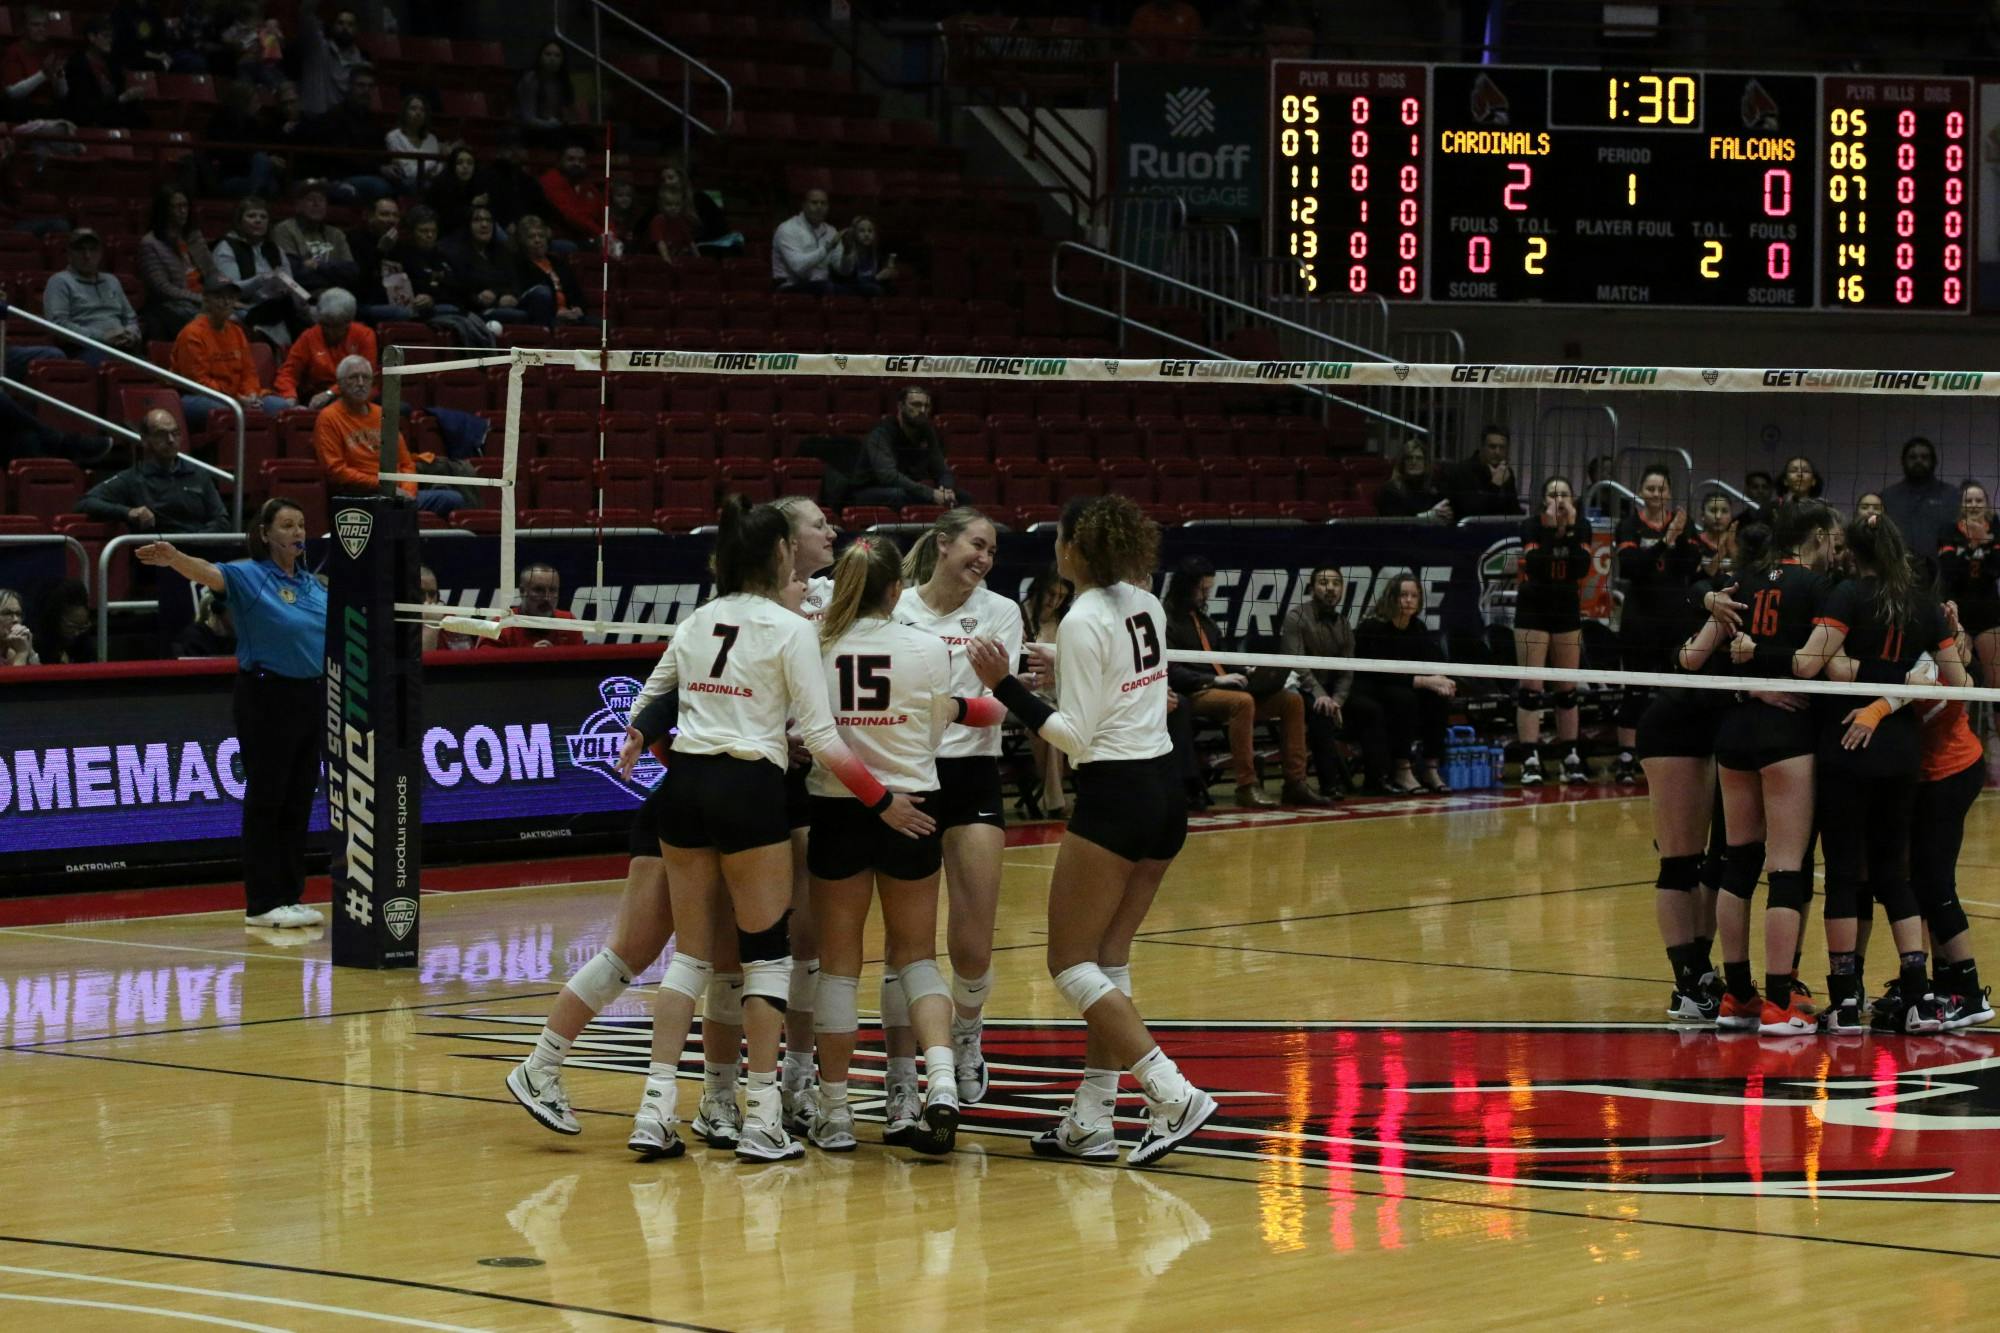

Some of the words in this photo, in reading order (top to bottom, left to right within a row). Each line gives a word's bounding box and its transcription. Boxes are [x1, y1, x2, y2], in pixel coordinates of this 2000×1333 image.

[1299, 70, 1329, 88] PLYR
[1336, 71, 1369, 88] KILLS
[1377, 73, 1406, 89] DIGS
[1282, 95, 1319, 123] 05
[1352, 96, 1369, 124] 0
[1402, 98, 1418, 125] 0
[1610, 76, 1695, 124] 1:30
[1831, 109, 1867, 136] 05
[1898, 110, 1915, 137] 0
[1946, 112, 1964, 138] 0
[1282, 129, 1319, 156] 07
[1352, 130, 1368, 157] 0
[1411, 134, 1418, 156] 1
[1442, 131, 1550, 155] CARDINALS
[1598, 148, 1651, 164] PERIOD
[1711, 137, 1795, 161] FALCONS
[1830, 142, 1866, 169] 06
[1898, 143, 1915, 170] 0
[1946, 145, 1963, 171] 0
[1129, 143, 1251, 180] Ruoff
[1292, 165, 1318, 188] 11
[1351, 164, 1368, 191] 0
[1401, 165, 1418, 192] 0
[1504, 163, 1531, 210] 2
[1629, 174, 1636, 205] 1
[1764, 169, 1791, 216] 0
[1830, 175, 1866, 202] 07
[1897, 176, 1914, 203] 0
[1945, 178, 1962, 205] 0
[1291, 197, 1318, 224] 12
[1361, 200, 1367, 222] 1
[1400, 199, 1417, 226] 0
[1450, 217, 1499, 232] FOULS
[1840, 211, 1865, 233] 11
[1897, 210, 1914, 237] 0
[1945, 211, 1962, 238] 0
[1576, 219, 1632, 236] PLAYER
[1638, 220, 1675, 237] FOUL
[1750, 224, 1797, 239] FOULS
[1291, 231, 1317, 258] 13
[1350, 232, 1367, 259] 0
[1400, 232, 1416, 260] 0
[1469, 236, 1490, 273] 0
[1525, 237, 1547, 274] 2
[1701, 241, 1722, 278] 2
[1839, 244, 1865, 266] 14
[1897, 243, 1913, 270] 0
[1944, 244, 1961, 271] 0
[1768, 243, 1790, 279] 0
[1350, 265, 1366, 292] 0
[1399, 266, 1416, 293] 0
[1450, 282, 1497, 298] SCORE
[1839, 275, 1864, 302] 16
[1896, 276, 1913, 303] 0
[1944, 277, 1961, 304] 0
[1597, 286, 1649, 302] MATCH
[1748, 288, 1795, 304] SCORE
[340, 525, 369, 537] MAC
[1751, 587, 1783, 637] 16
[708, 623, 740, 679] 7
[1125, 611, 1161, 674] 13
[687, 683, 753, 698] ARDINALS
[835, 654, 891, 711] 15
[327, 656, 341, 757] SOME
[834, 714, 908, 726] ARDINALS
[422, 723, 555, 787] COM
[328, 762, 344, 832] GET
[396, 776, 408, 825] sports
[519, 829, 572, 840] DAKTRONICS
[66, 861, 127, 873] DAKTRONICS
[394, 828, 407, 888] imports
[387, 911, 414, 922] MAC
